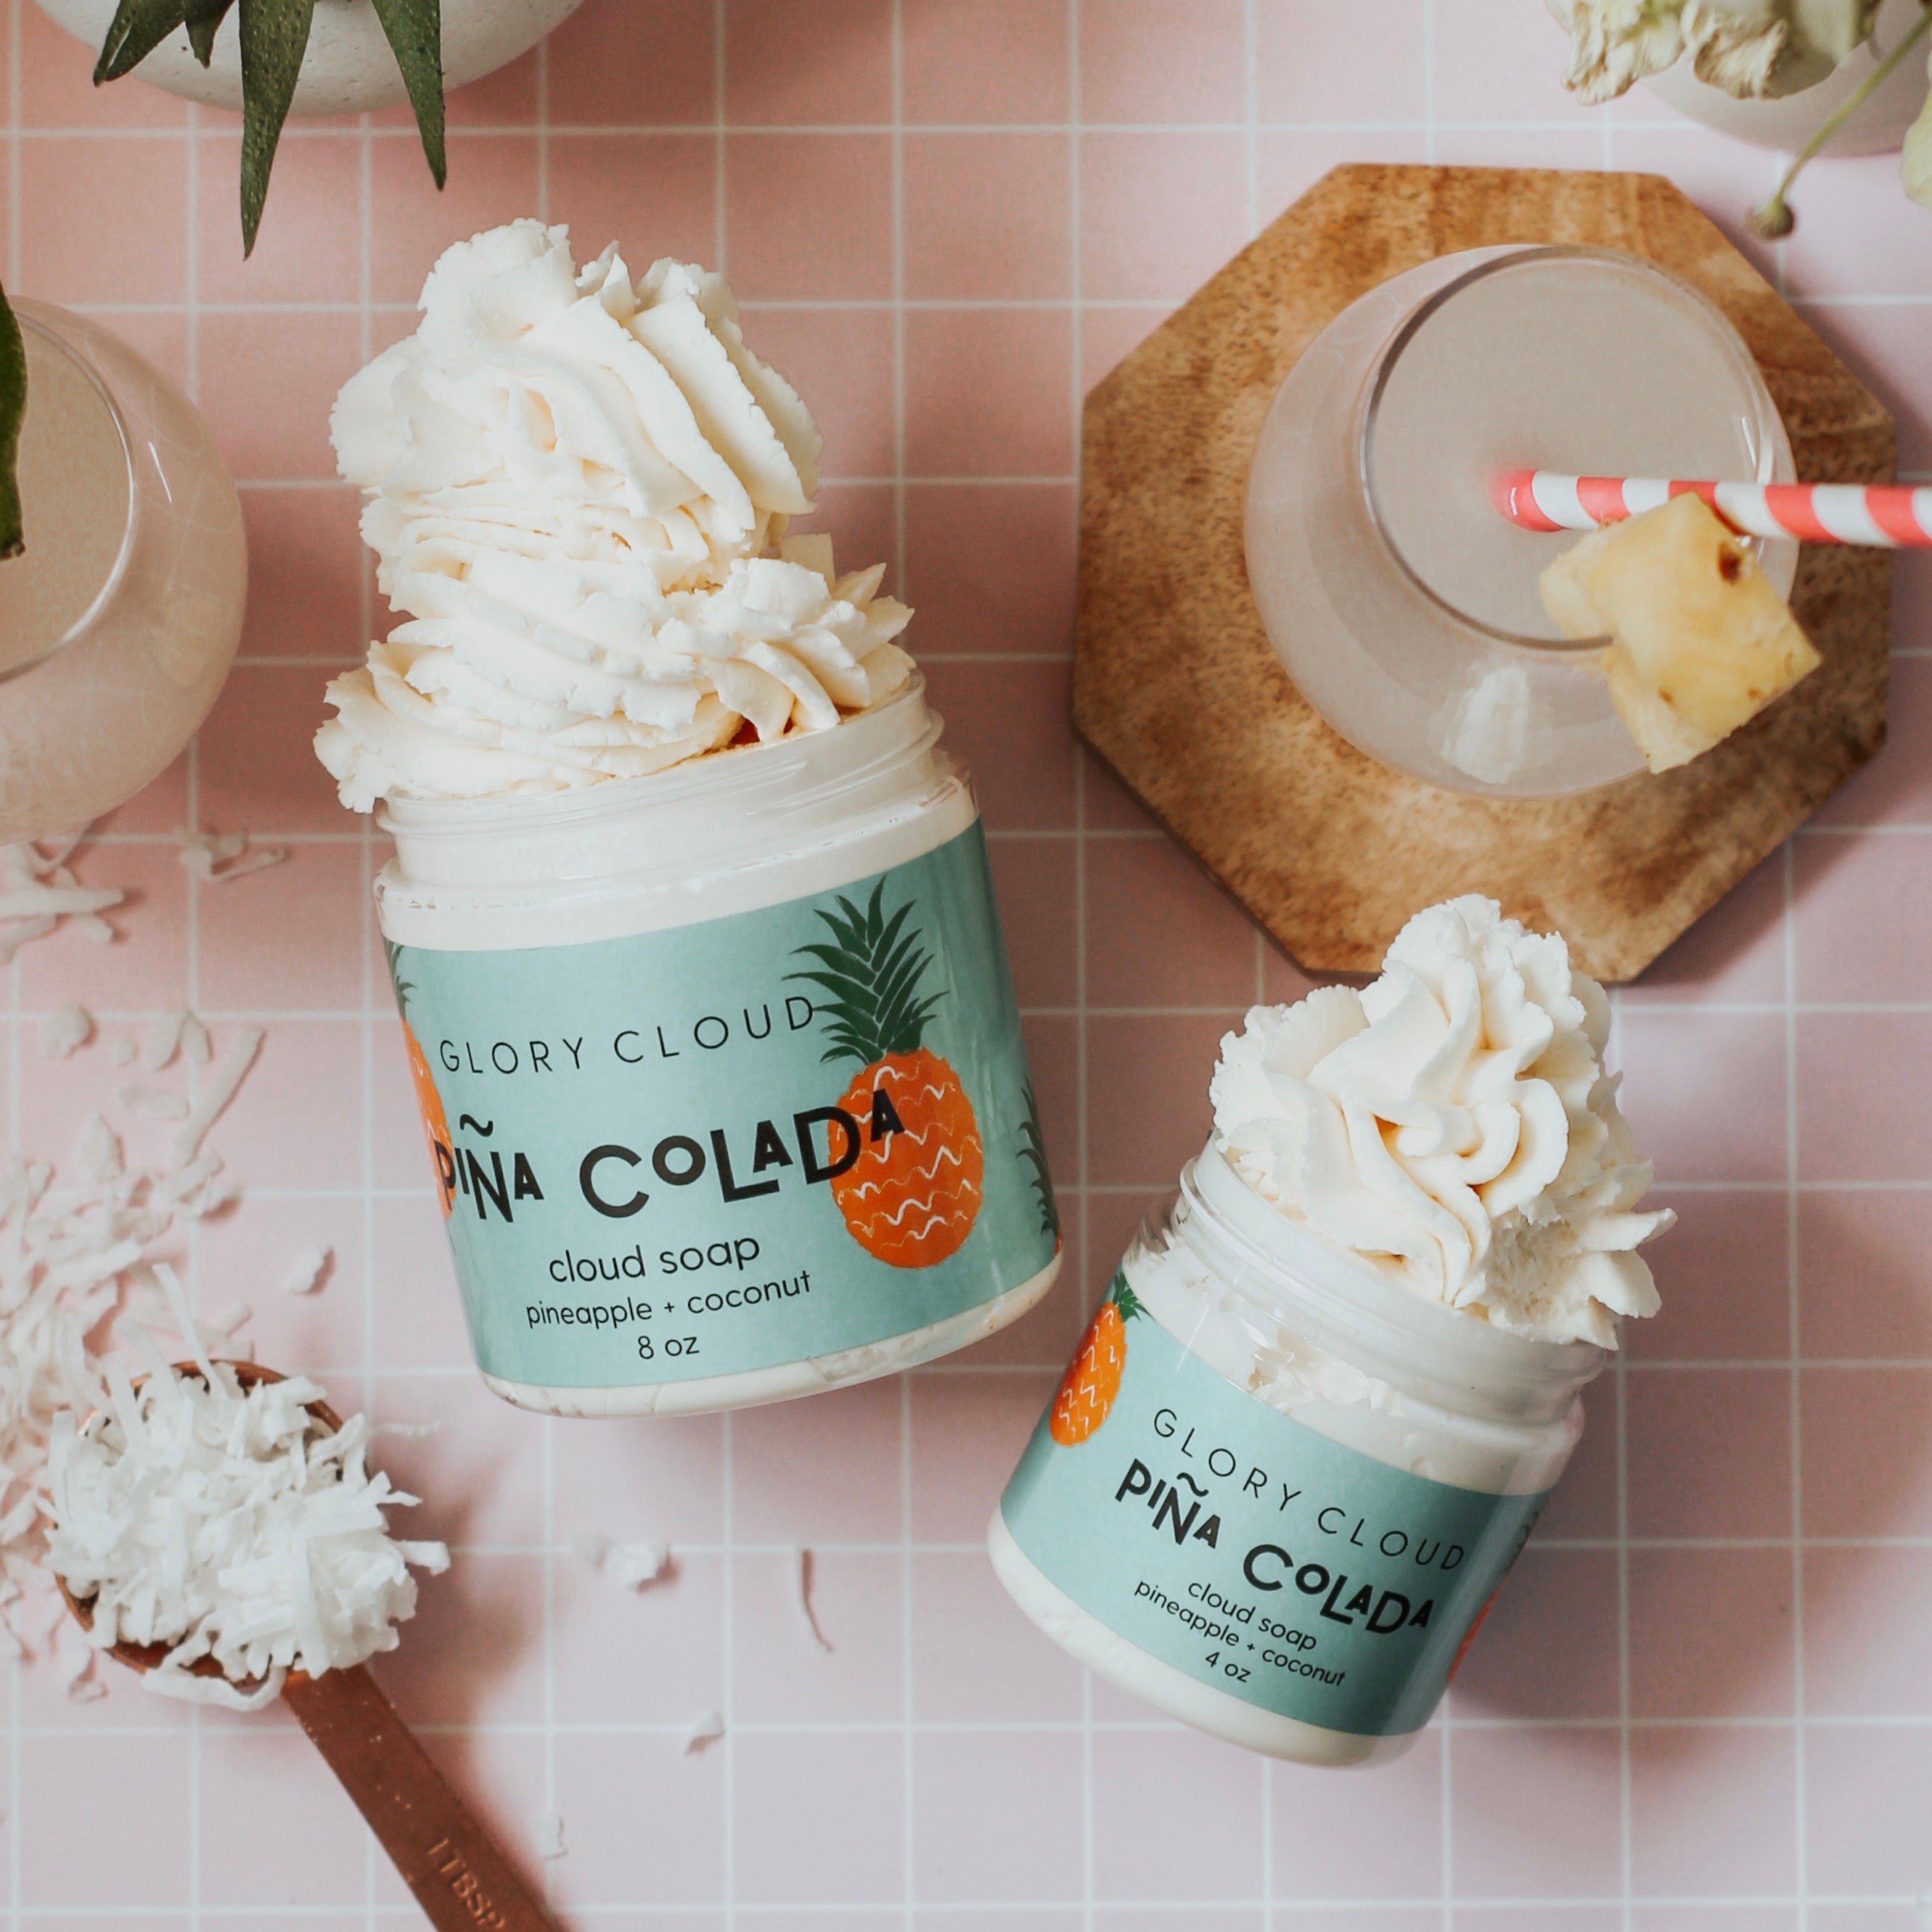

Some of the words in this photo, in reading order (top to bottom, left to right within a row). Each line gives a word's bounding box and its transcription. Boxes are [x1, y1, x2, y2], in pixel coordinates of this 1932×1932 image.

[440, 1036, 583, 1074] GLORY
[613, 996, 814, 1064] CLOUD
[433, 1113, 545, 1224] PIÑA
[549, 1244, 646, 1283] cloud
[659, 1237, 760, 1274] soap
[525, 1296, 652, 1330] pineapple
[663, 1301, 675, 1313] +
[687, 1270, 811, 1314] coconut
[637, 1335, 655, 1360] 8
[664, 1336, 700, 1357] oz
[1114, 1457, 1221, 1550] PIÑA
[1153, 1408, 1302, 1512] GLORY
[1317, 1507, 1465, 1571] CLOUD
[1134, 1581, 1240, 1647] pineapple
[1261, 1647, 1346, 1687] coconut
[1188, 1581, 1256, 1625] cloud
[1258, 1618, 1317, 1652] soap
[1205, 1651, 1221, 1668] 4
[1224, 1663, 1252, 1683] oz
